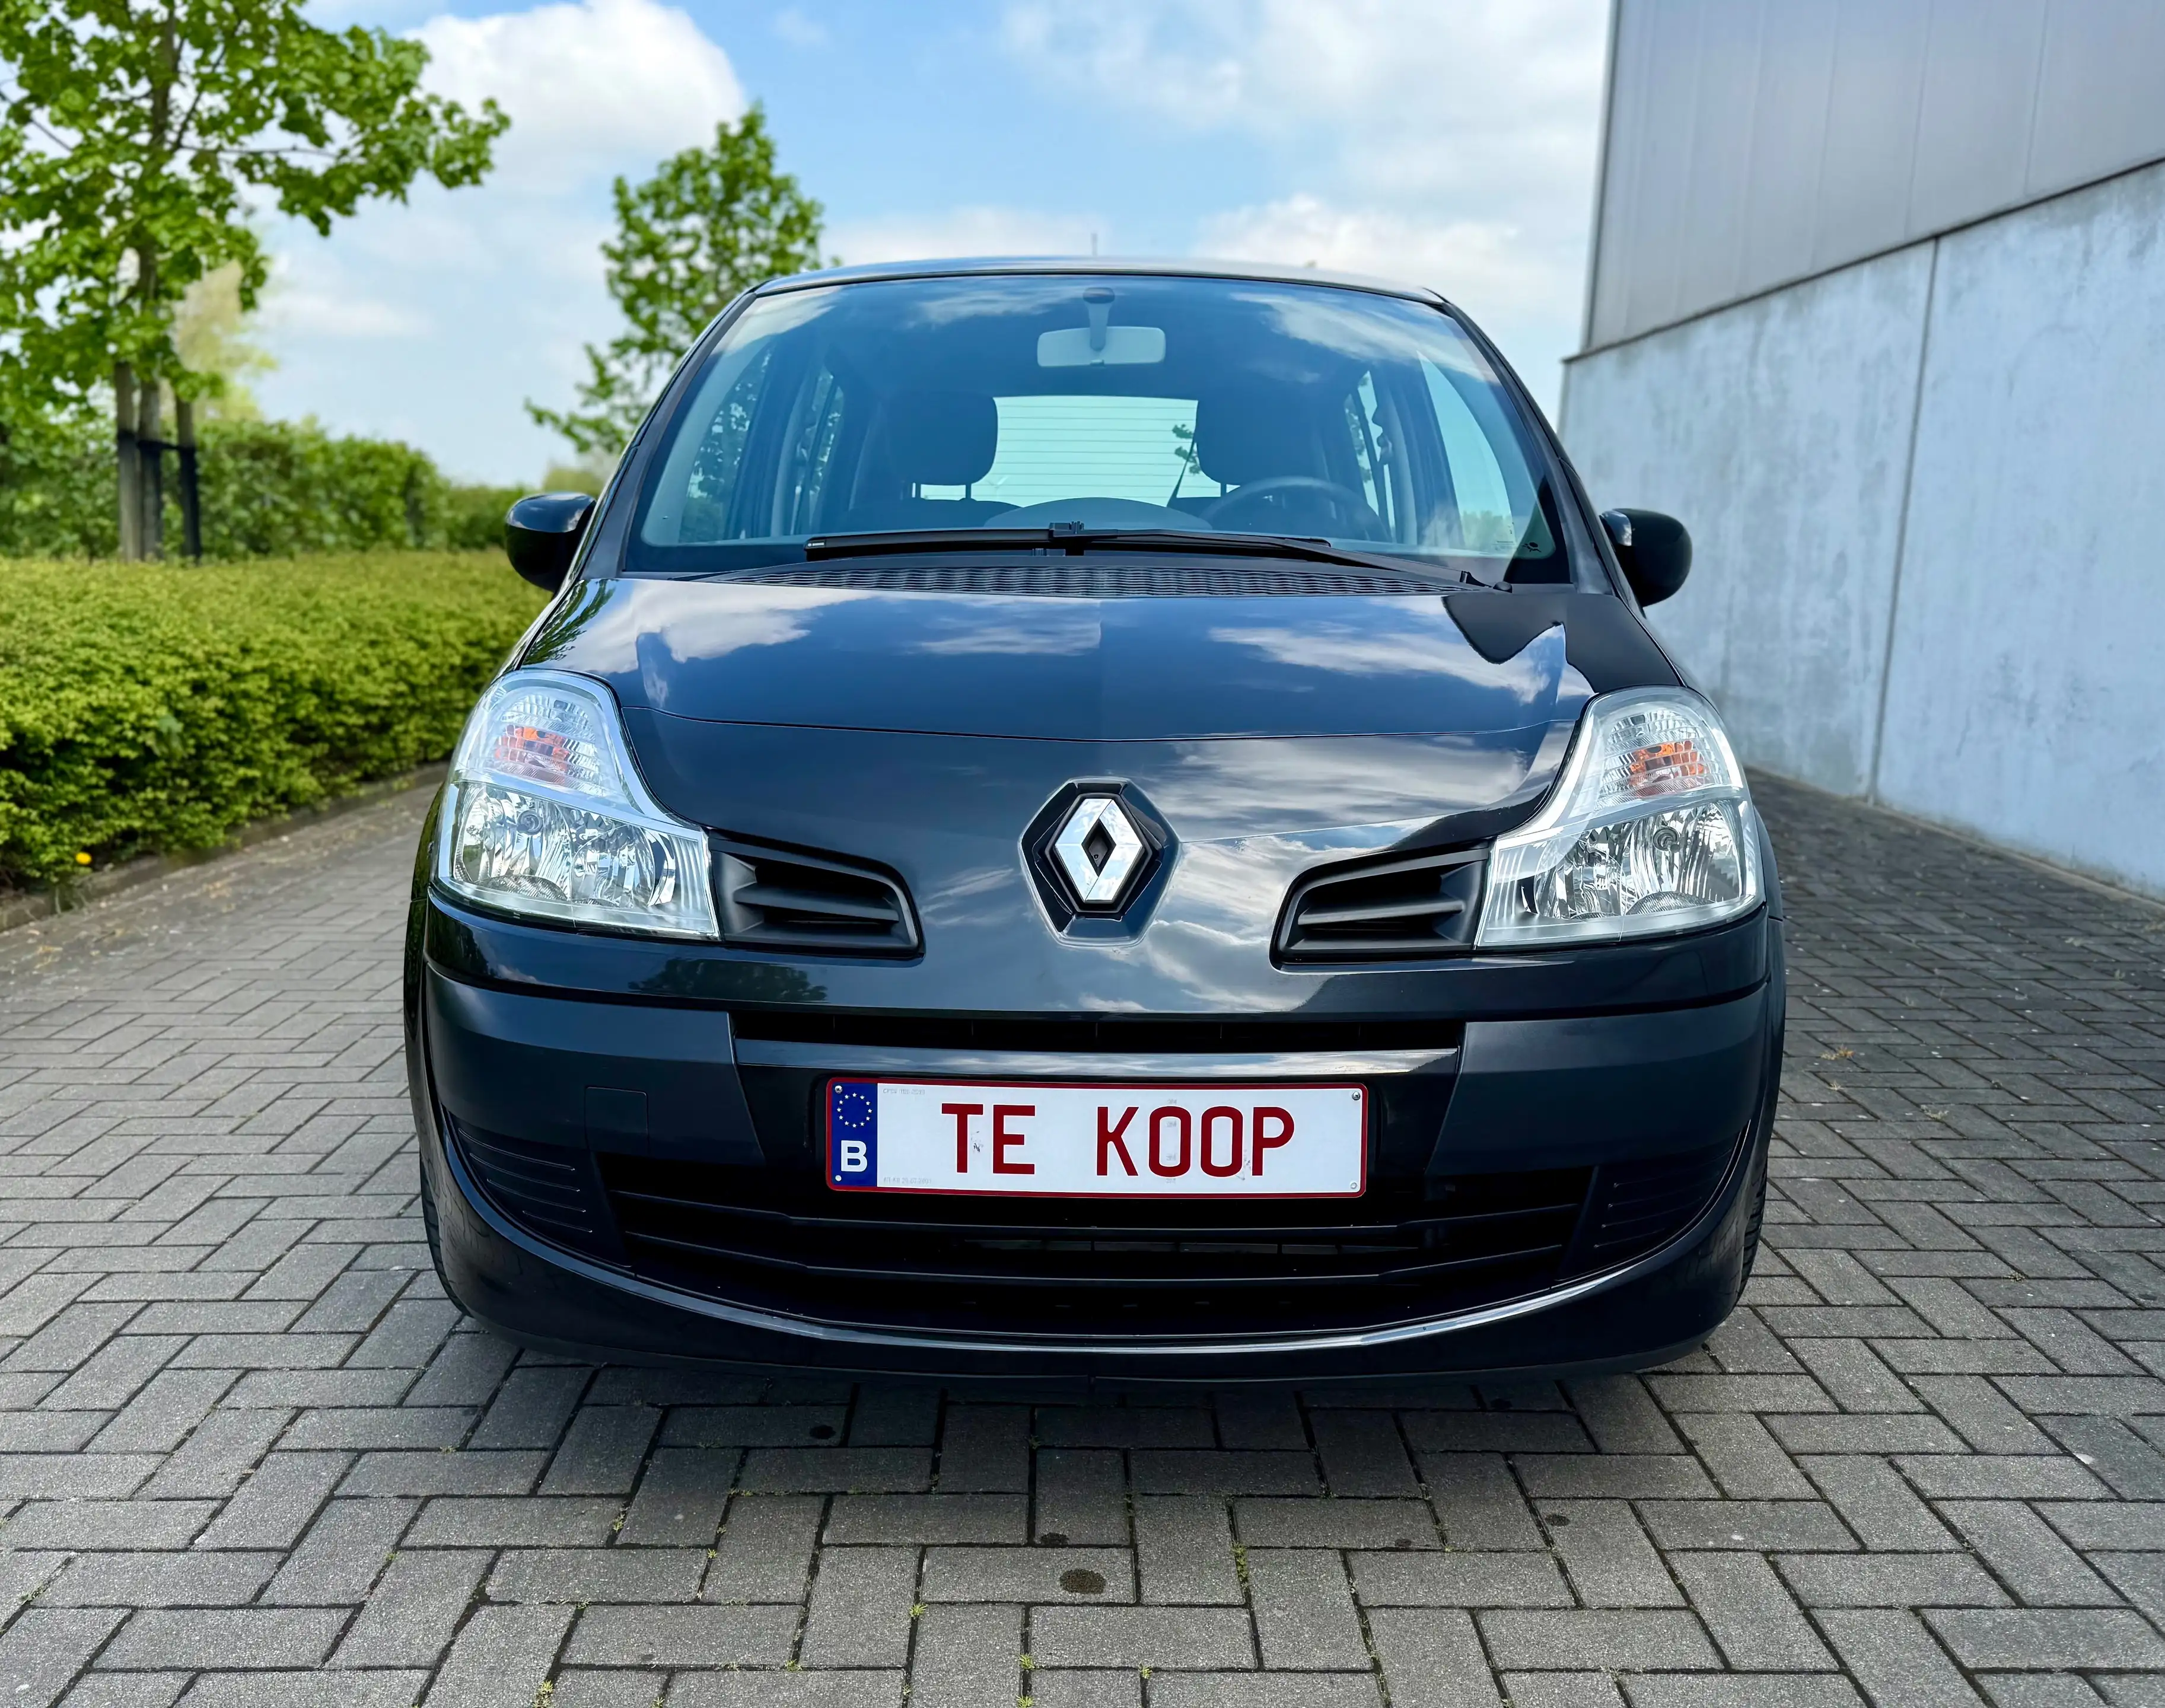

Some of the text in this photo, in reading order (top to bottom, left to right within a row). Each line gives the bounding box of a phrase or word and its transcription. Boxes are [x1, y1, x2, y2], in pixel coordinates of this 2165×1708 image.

[841, 1140, 868, 1172] B
[941, 1103, 1295, 1177] TE KOOP
